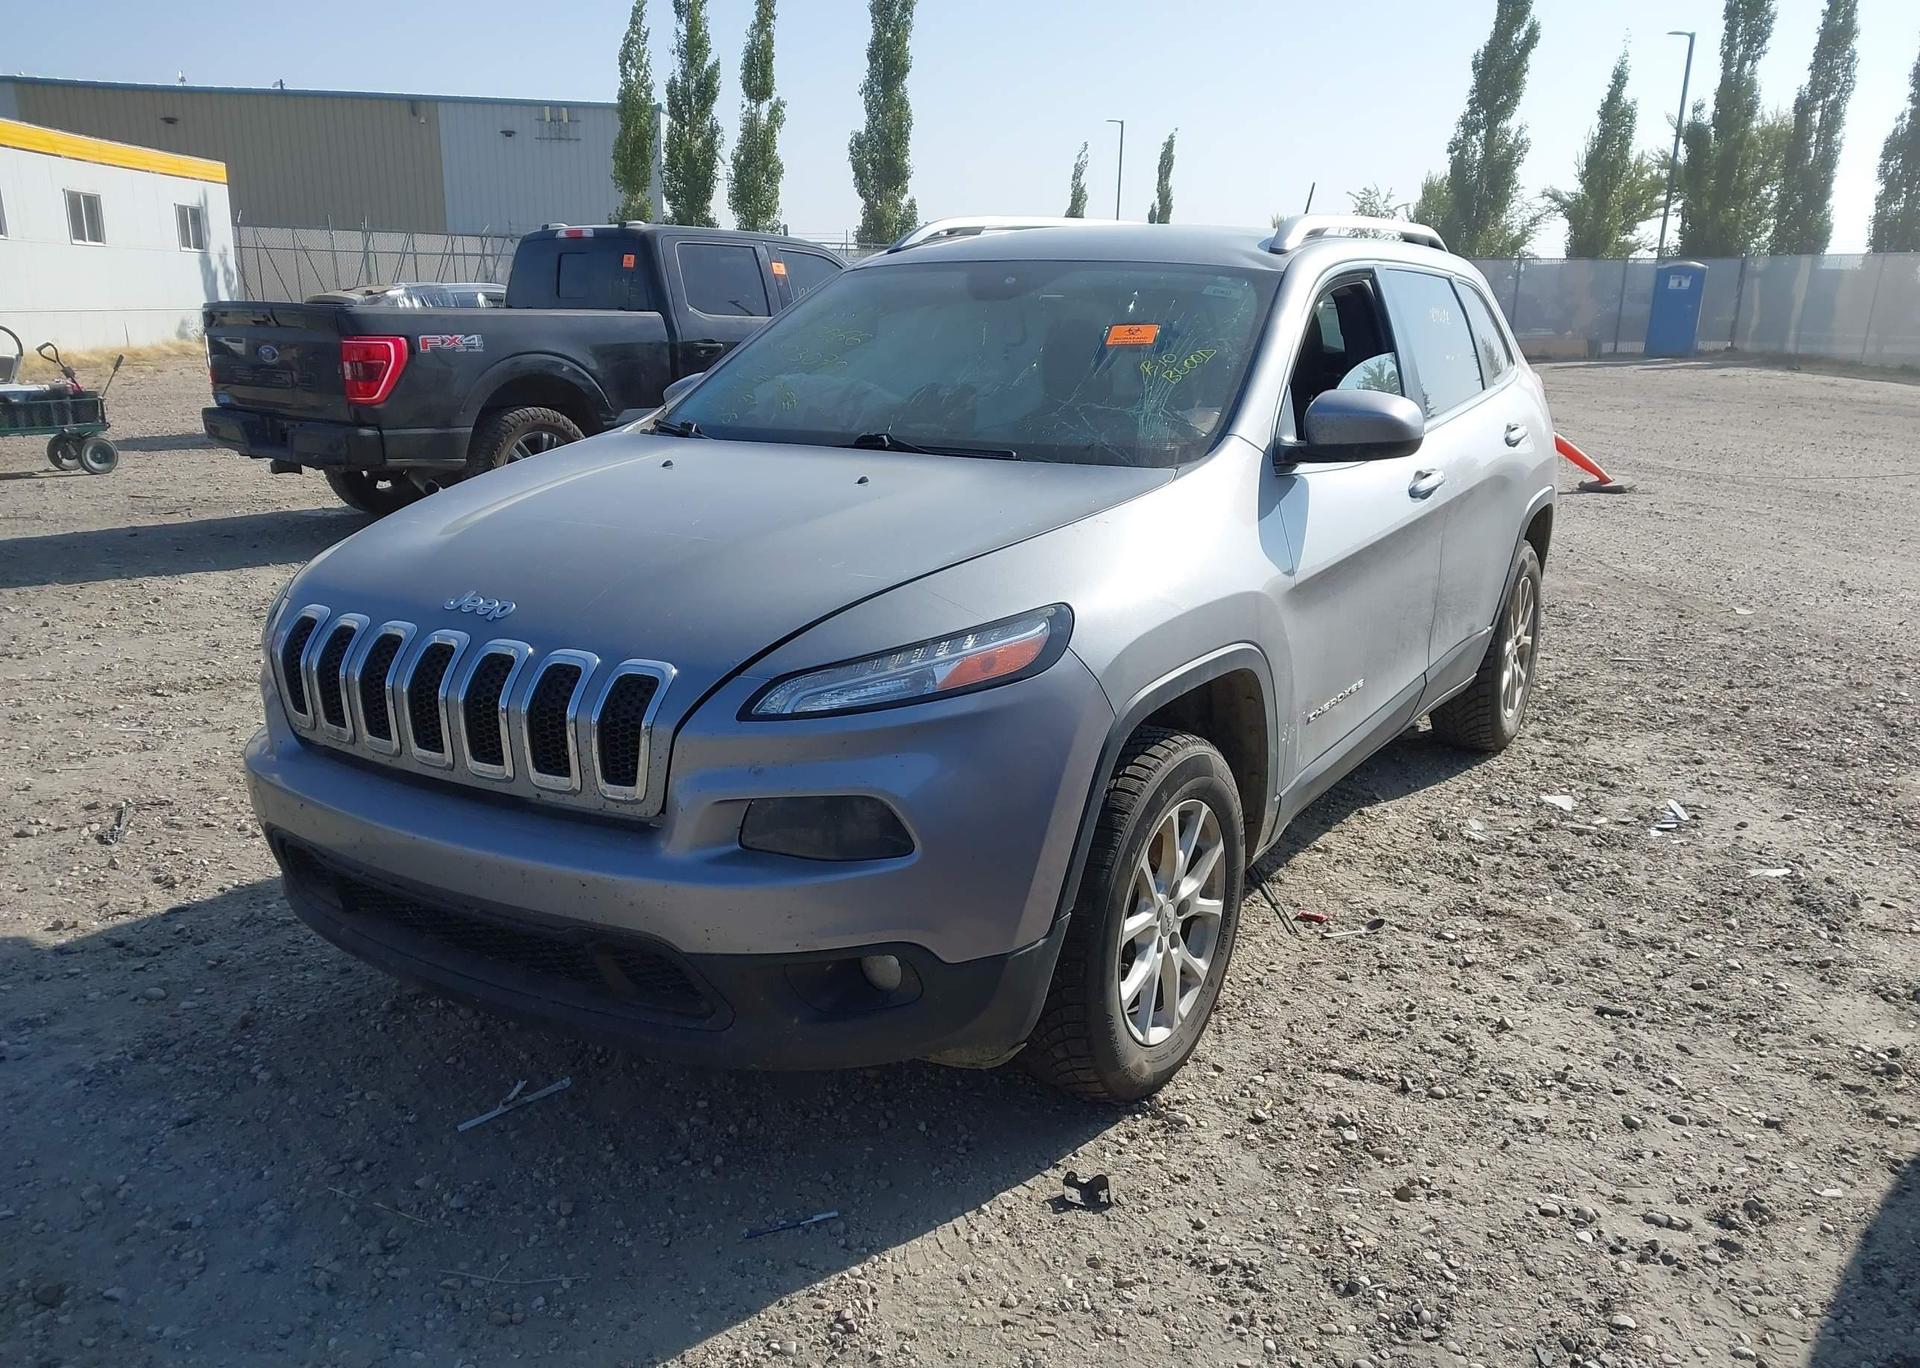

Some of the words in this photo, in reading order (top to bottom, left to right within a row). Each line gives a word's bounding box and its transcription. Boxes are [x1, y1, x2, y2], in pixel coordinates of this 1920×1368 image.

[418, 334, 484, 353] FX4
[1162, 349, 1217, 384] BLOOD
[442, 590, 516, 621] Jeep
